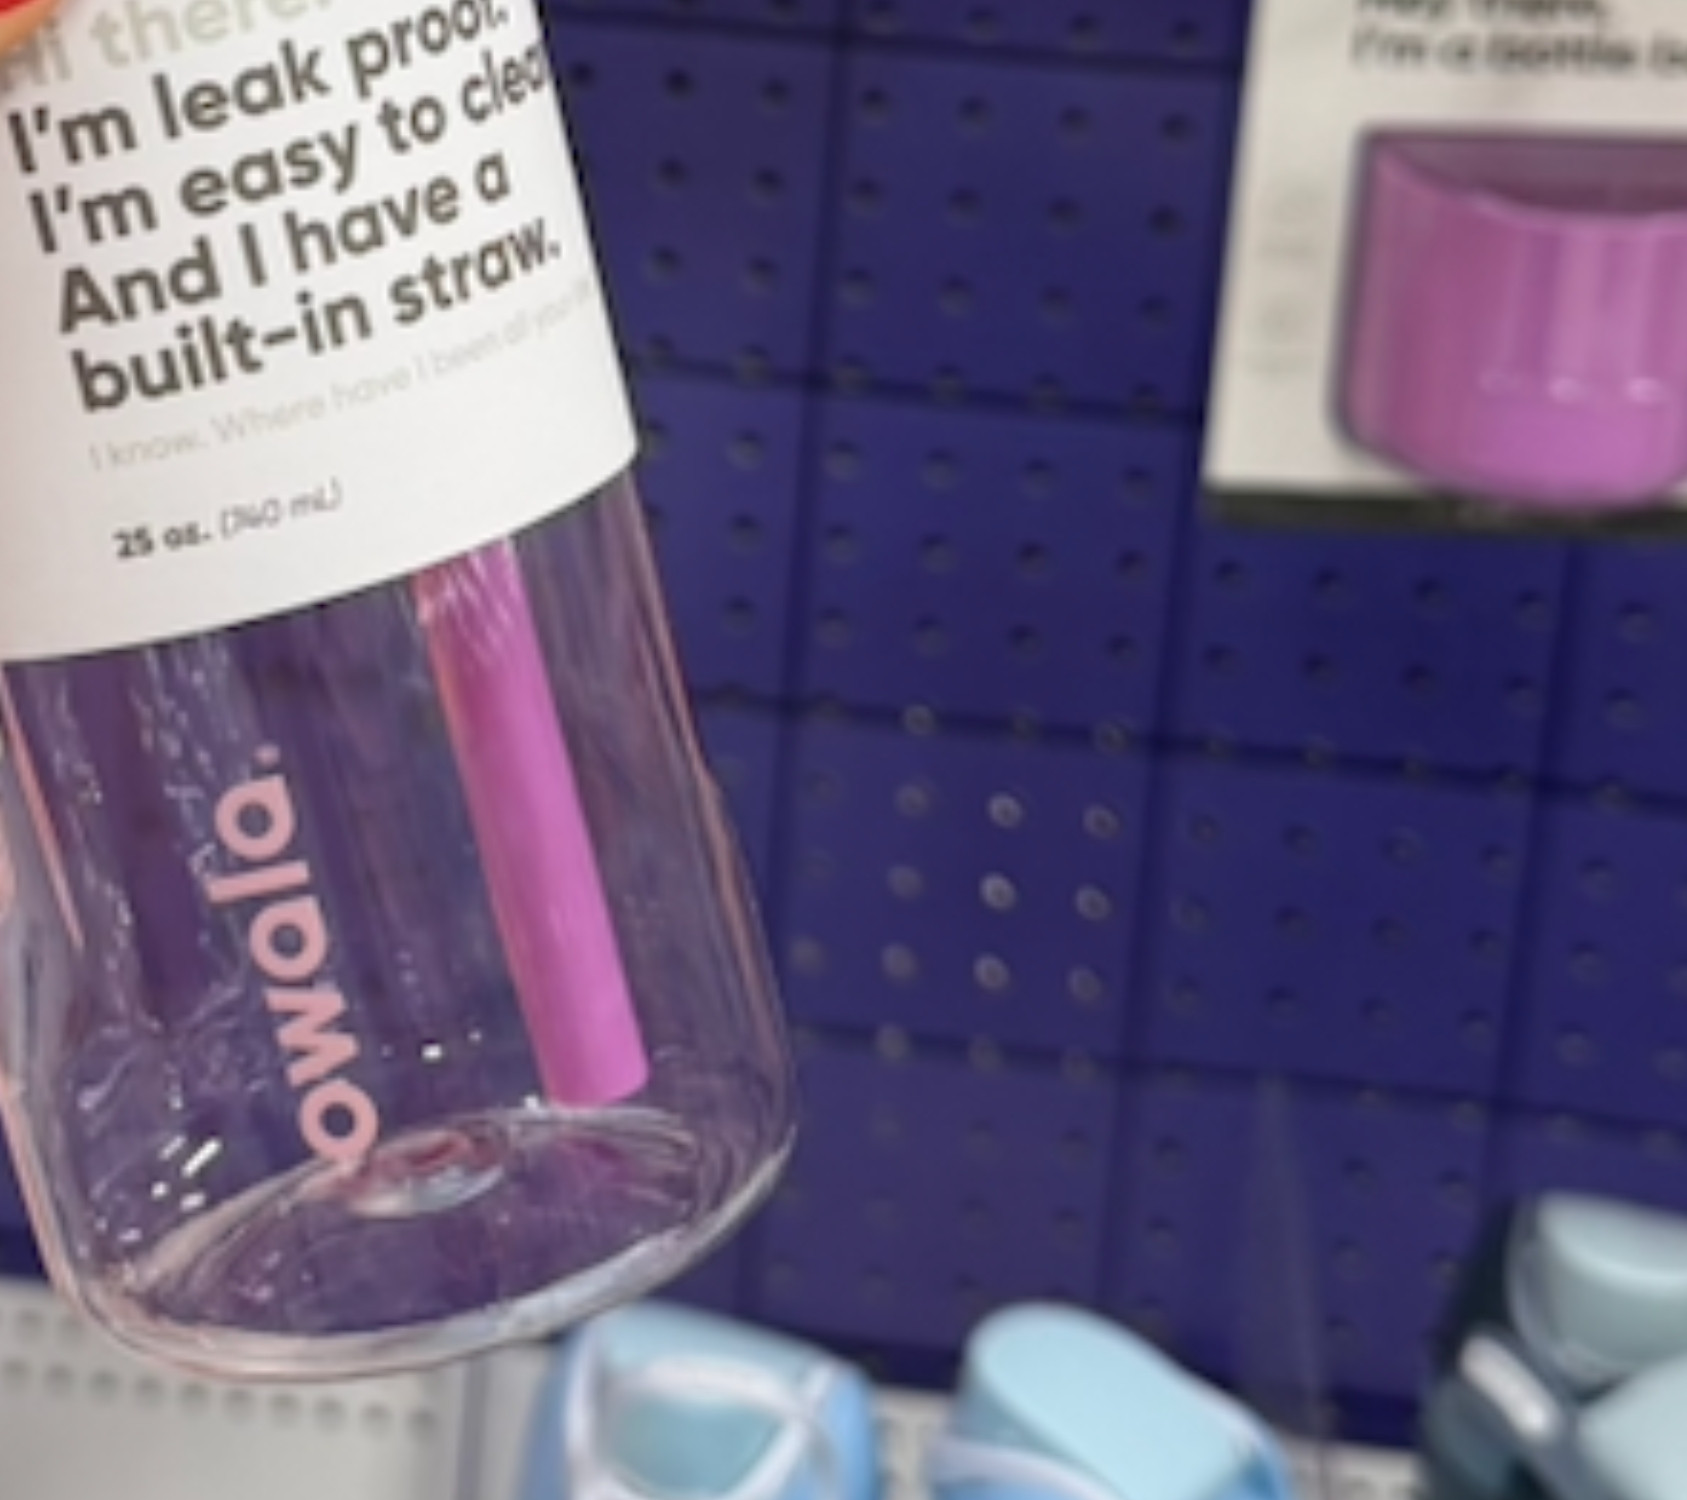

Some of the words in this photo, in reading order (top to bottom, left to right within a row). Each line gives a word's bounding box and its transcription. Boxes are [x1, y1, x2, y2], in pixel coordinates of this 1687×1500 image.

[8, 103, 137, 175] I'm
[152, 39, 332, 139] leak
[1434, 36, 1471, 73] a
[1484, 33, 1636, 77] bottle
[28, 181, 159, 254] I'm
[179, 122, 358, 217] easy
[376, 96, 448, 156] to
[459, 41, 546, 124] clea
[57, 236, 224, 335] And
[237, 221, 271, 290] I
[282, 174, 462, 276] have
[473, 149, 511, 206] a
[69, 288, 374, 413] built-in
[390, 216, 562, 327] straw.
[104, 423, 208, 468] know.
[211, 388, 326, 445] Where
[330, 362, 410, 411] have
[112, 523, 155, 561] 25
[163, 520, 213, 550] oz.
